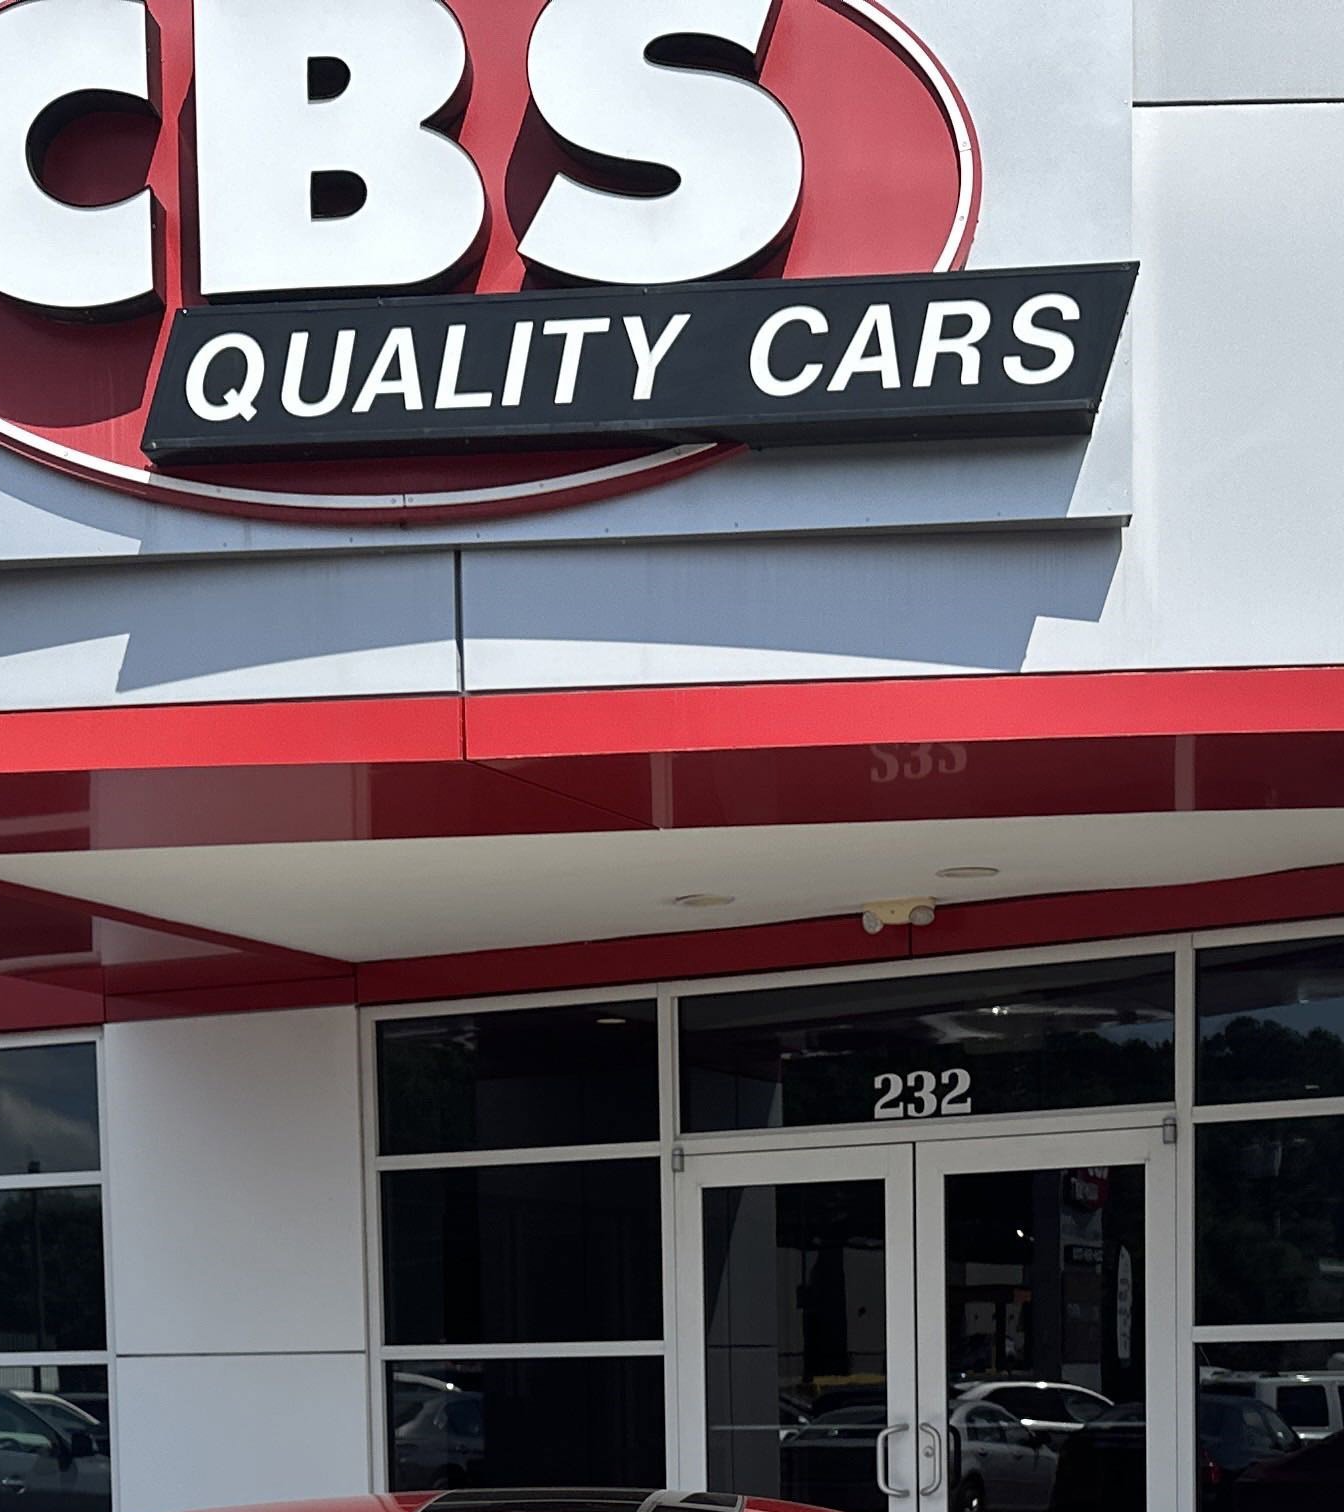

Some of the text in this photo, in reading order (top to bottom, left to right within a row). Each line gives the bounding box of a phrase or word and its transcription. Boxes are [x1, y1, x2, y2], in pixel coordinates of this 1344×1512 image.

[185, 293, 1080, 422] QUALITY CARS
[873, 1068, 972, 1120] 232
